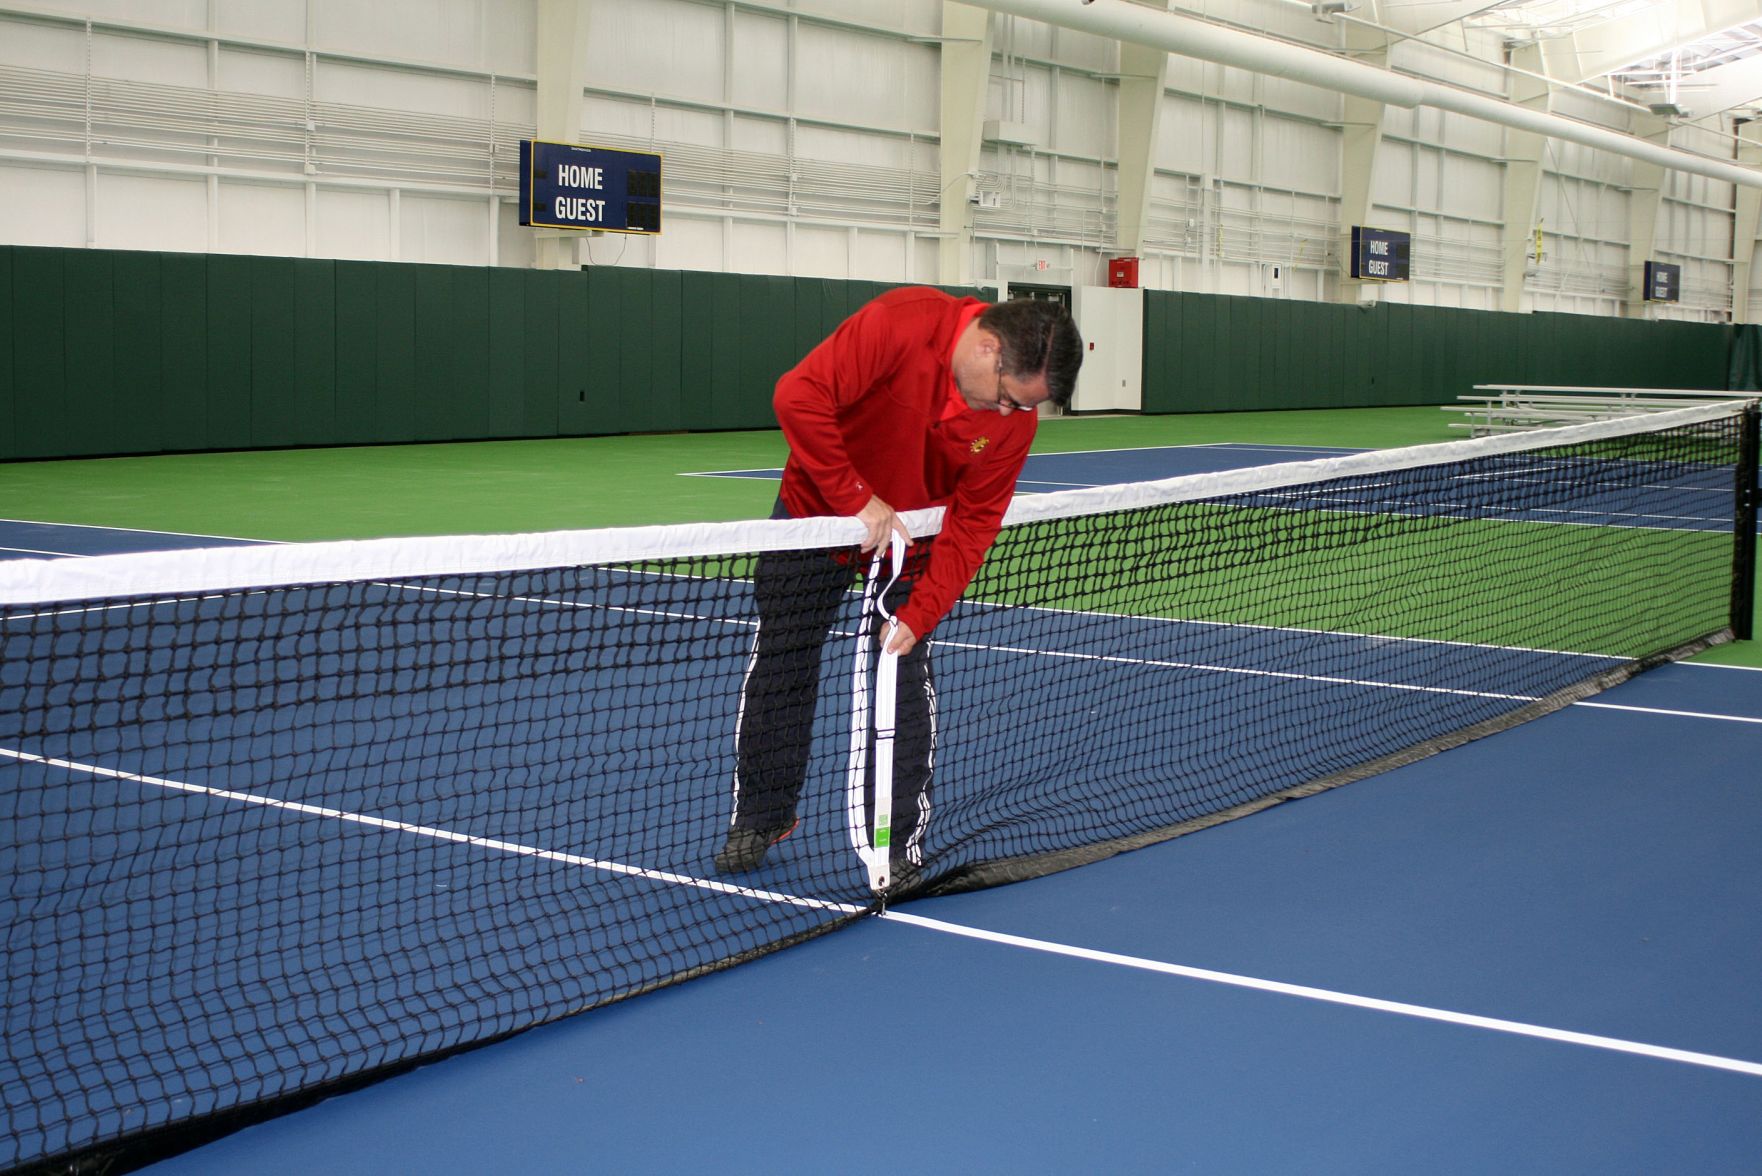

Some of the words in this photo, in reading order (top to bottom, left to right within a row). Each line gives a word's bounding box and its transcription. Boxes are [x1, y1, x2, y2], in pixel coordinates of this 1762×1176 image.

[558, 164, 603, 190] HOME
[555, 196, 606, 222] GUEST
[1370, 240, 1388, 256] HOME
[1368, 259, 1389, 276] GUEST
